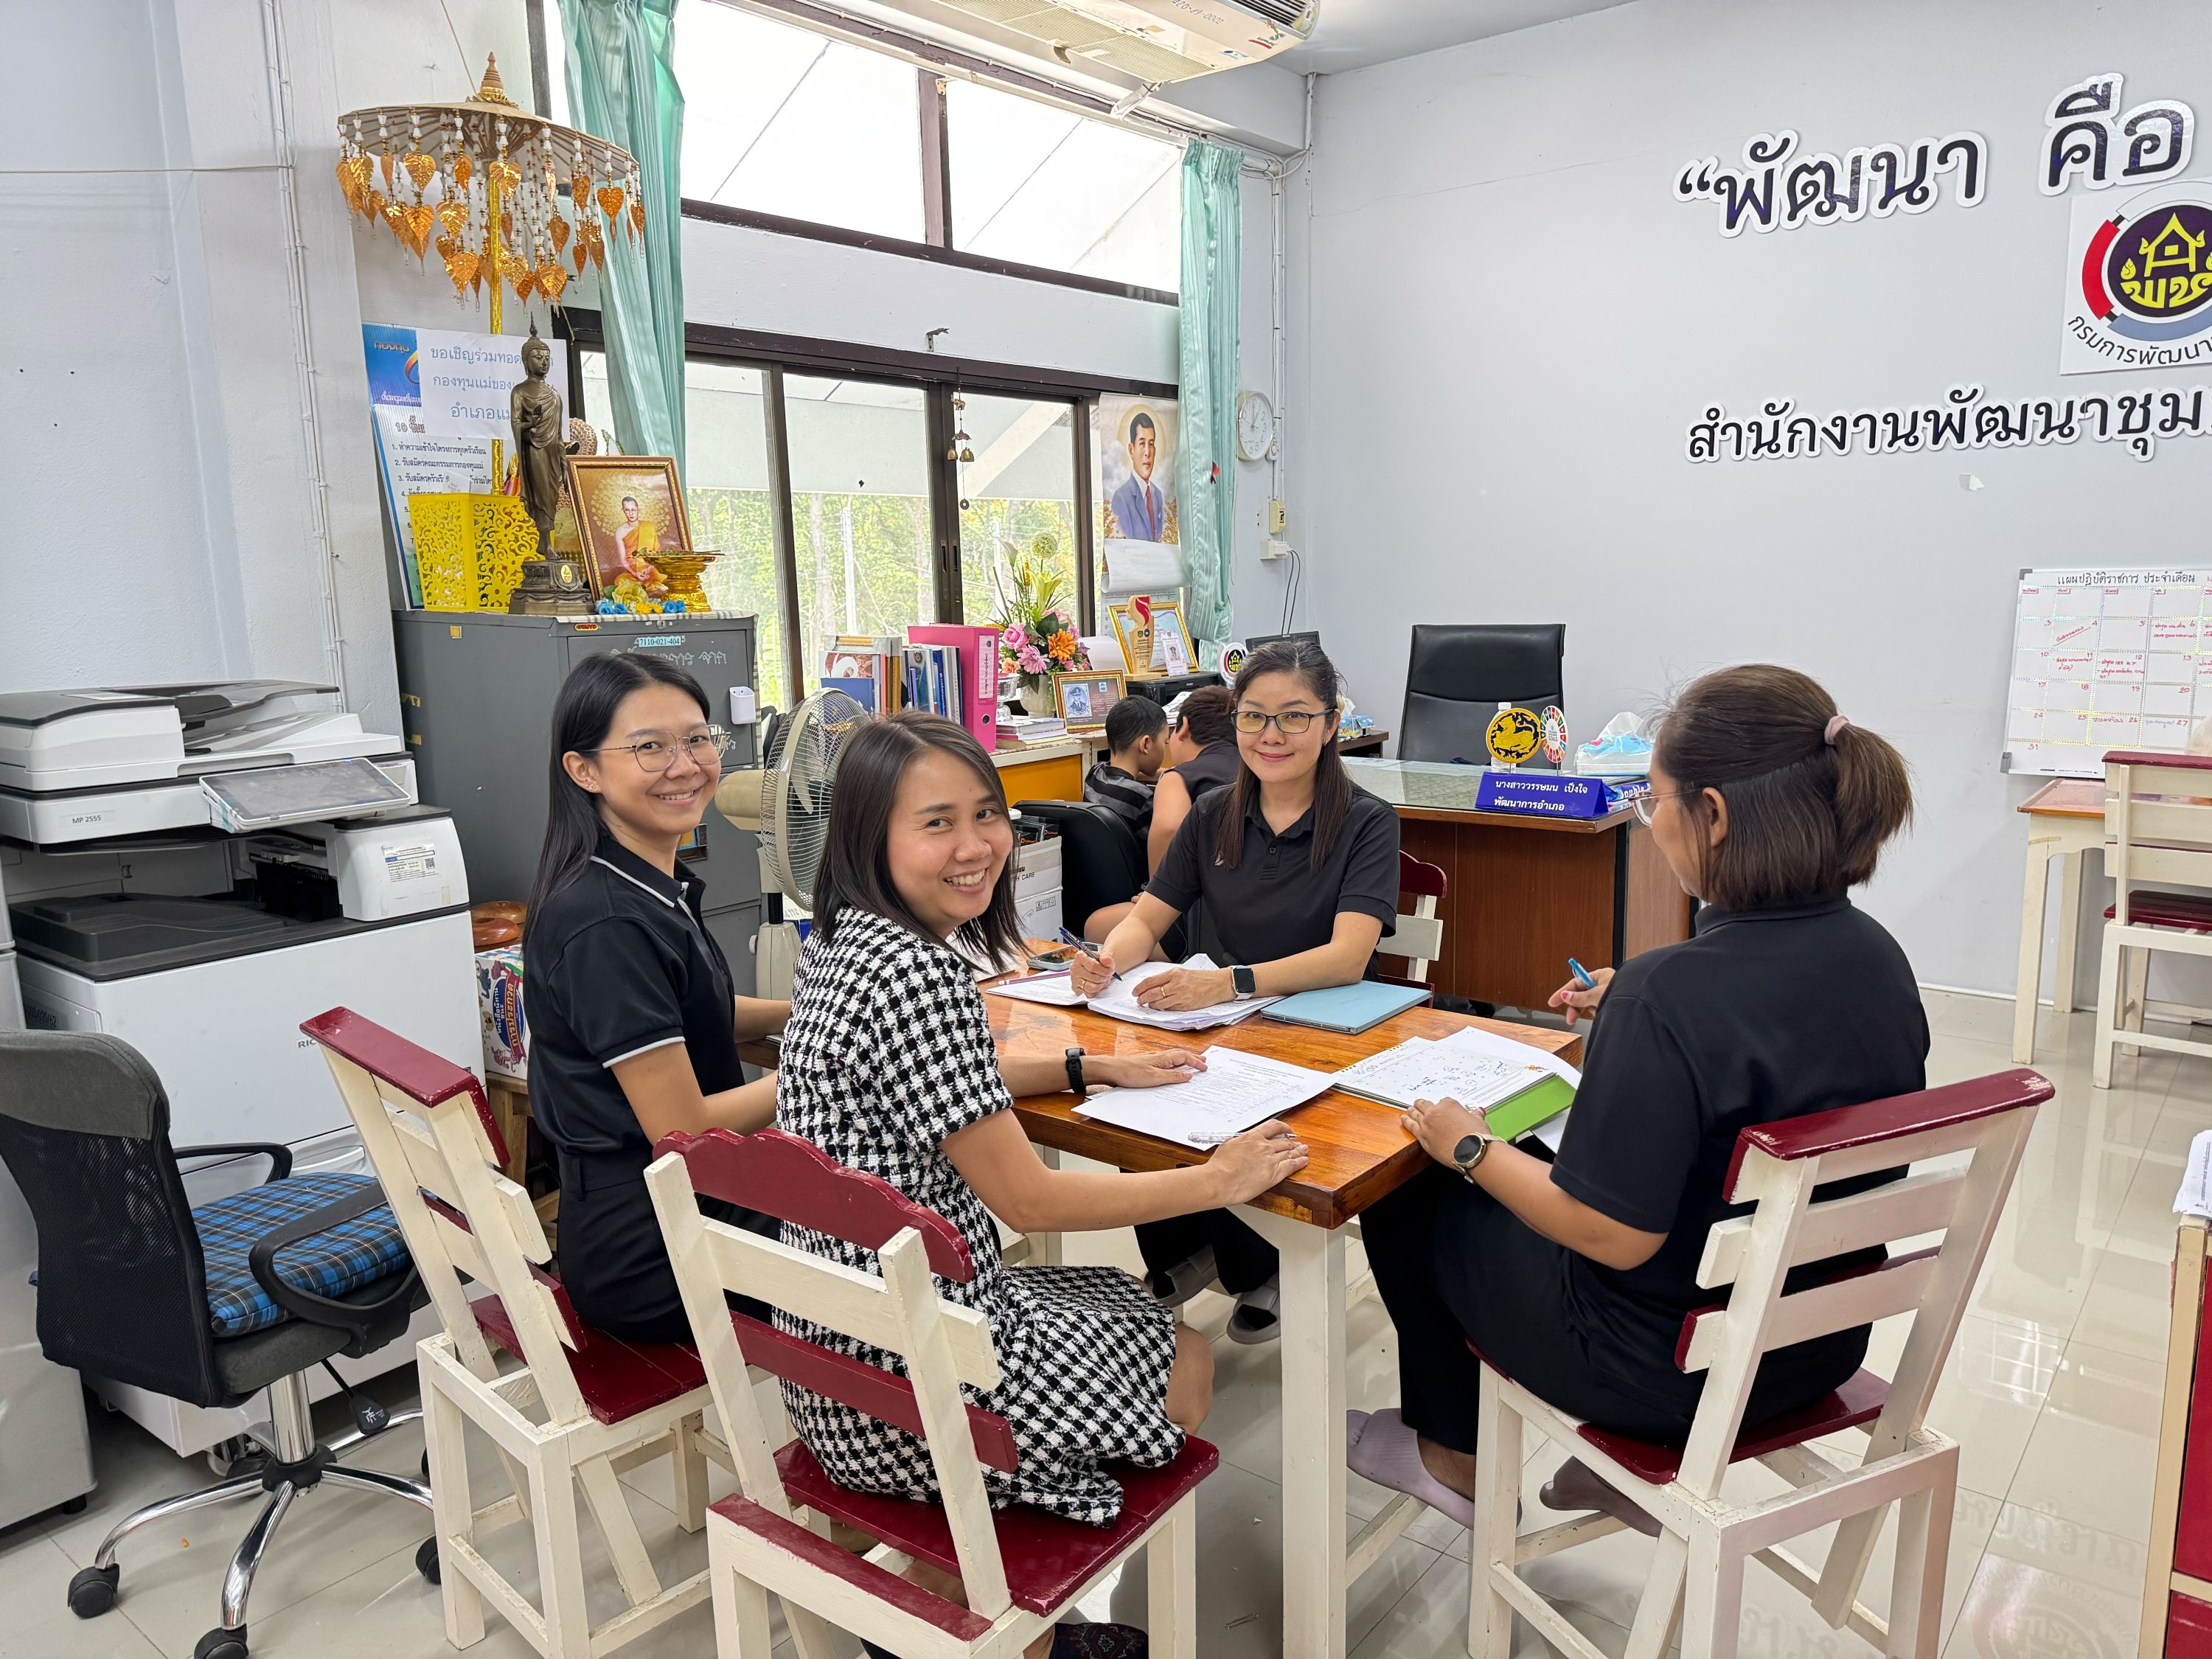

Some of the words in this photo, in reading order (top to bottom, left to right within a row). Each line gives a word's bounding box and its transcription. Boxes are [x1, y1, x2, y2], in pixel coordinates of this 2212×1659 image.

[2046, 80, 2184, 189] คือ
[433, 375, 516, 392] กองทุนแม่ของ
[1688, 386, 2212, 458] สำนักงานพัฒนาชุม
[639, 638, 680, 647] 7110-021-404
[1493, 796, 1565, 812] พัฒนาการอำเภอ
[85, 815, 102, 823] 2555
[298, 1038, 317, 1048] RIC
